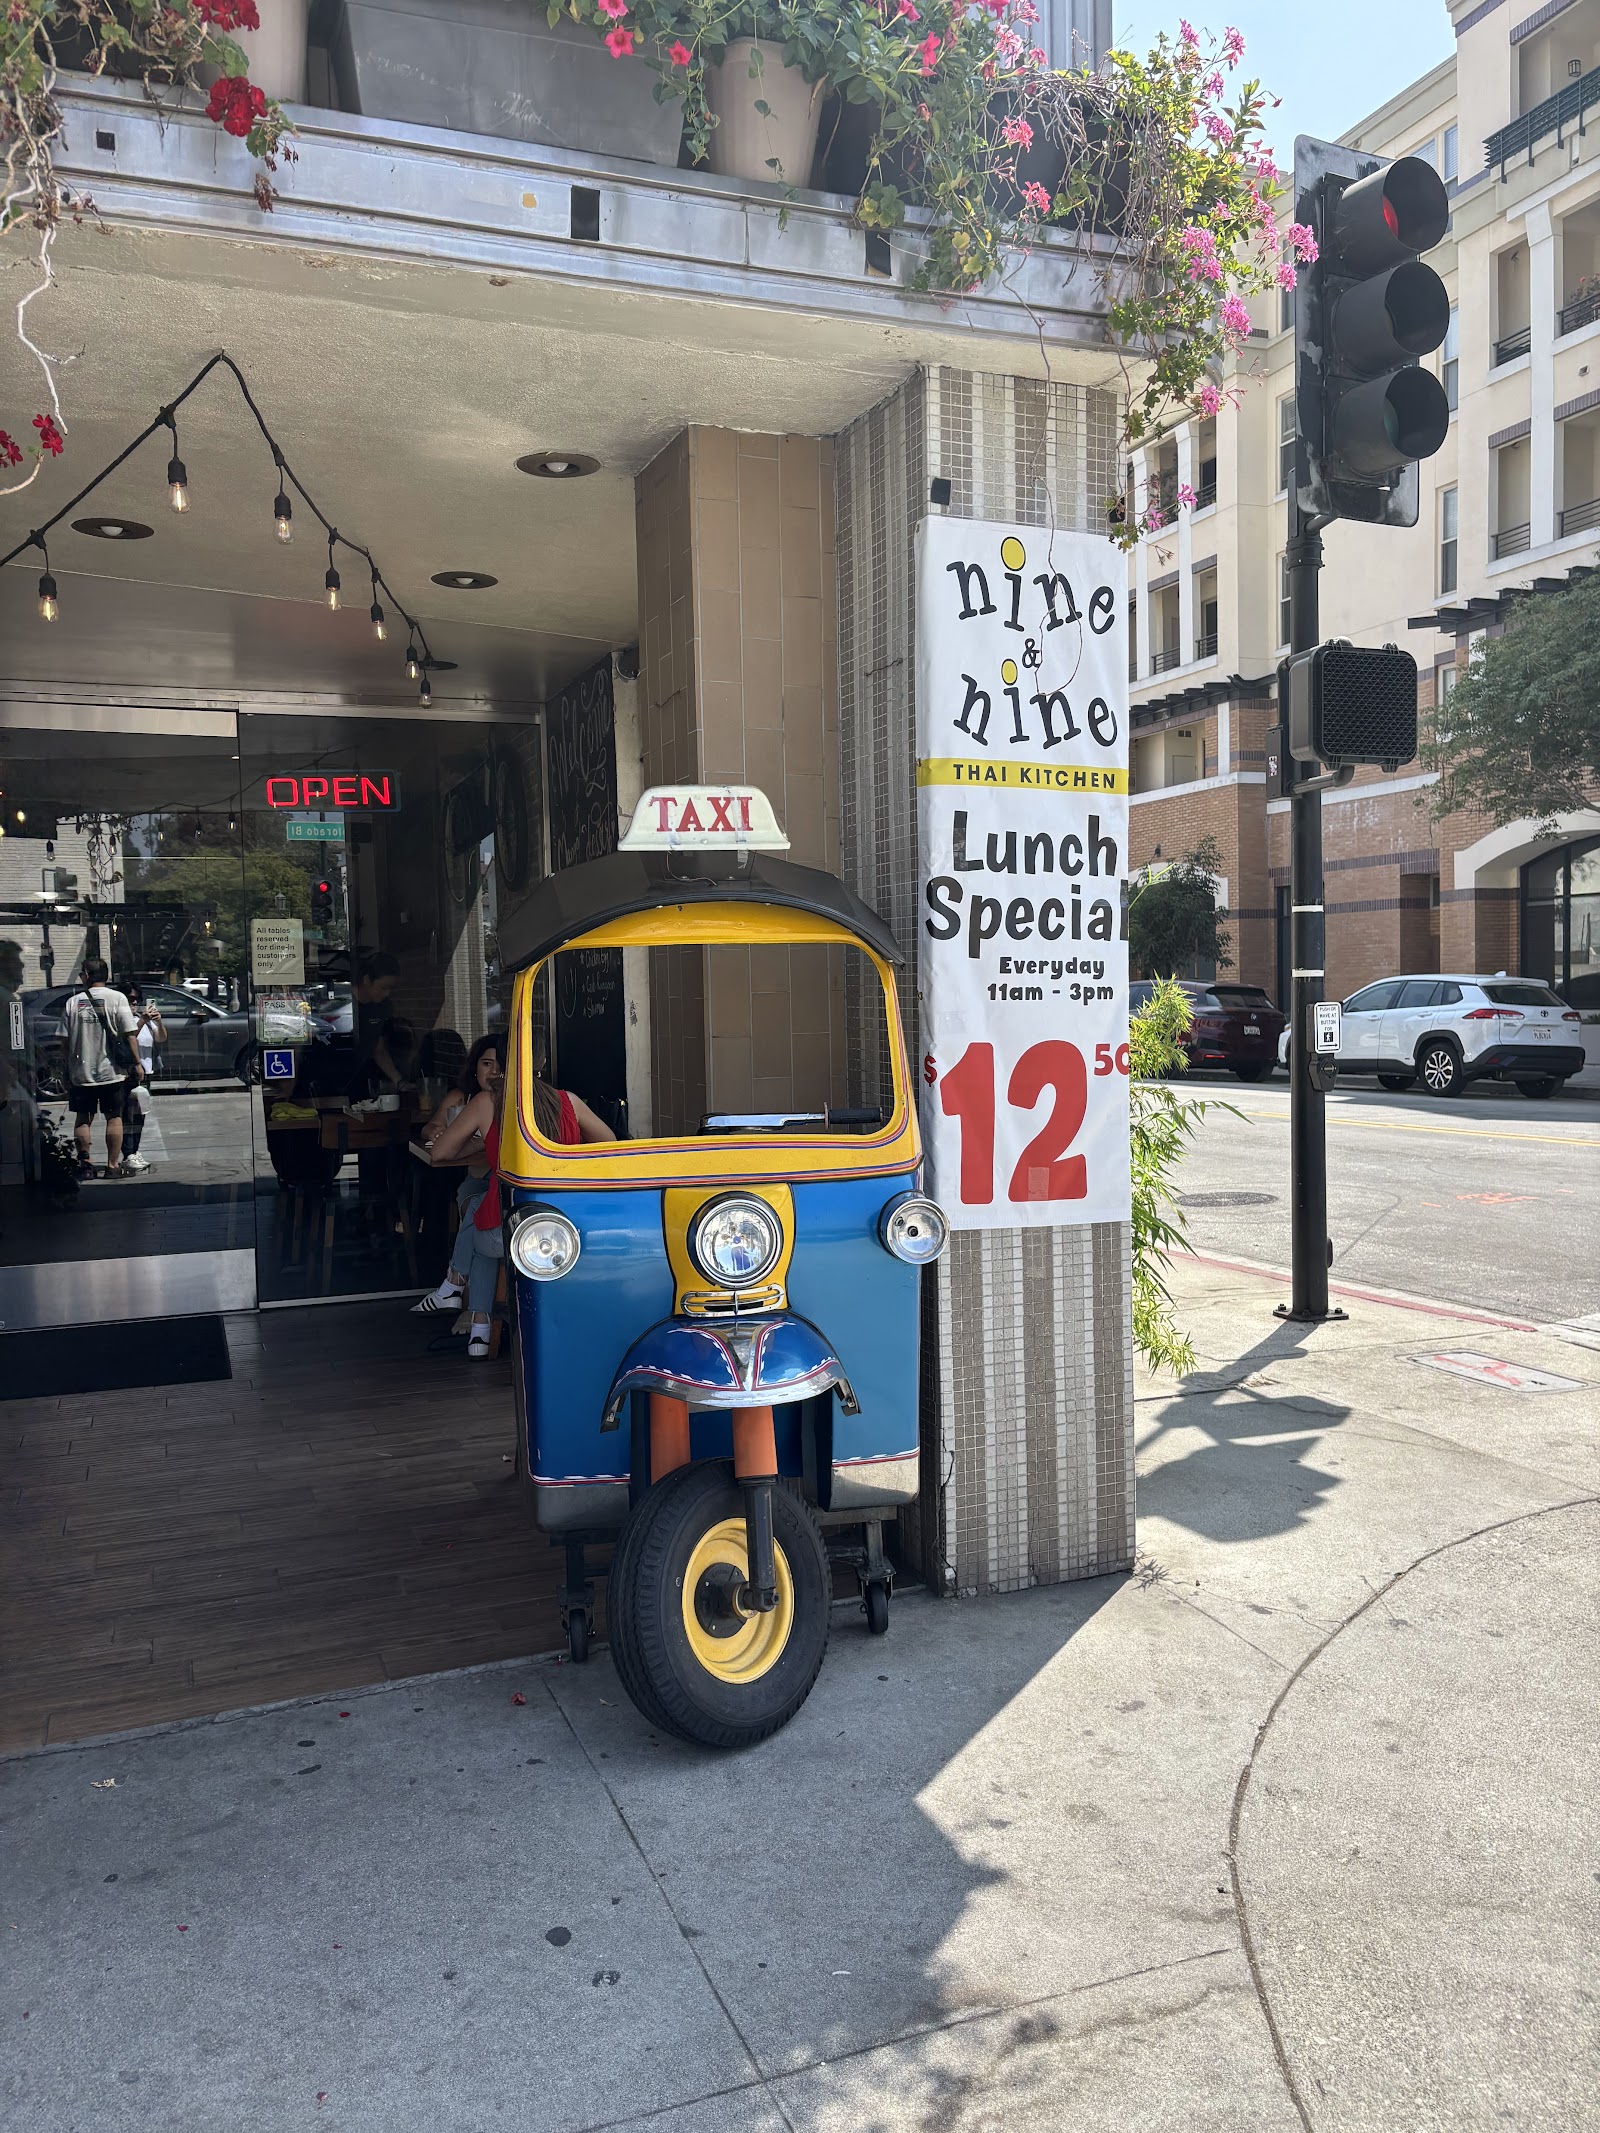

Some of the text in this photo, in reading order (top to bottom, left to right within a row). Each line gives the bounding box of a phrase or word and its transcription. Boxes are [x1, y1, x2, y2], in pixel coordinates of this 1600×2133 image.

[946, 536, 1115, 635] nine
[1021, 637, 1041, 669] &
[953, 658, 1118, 749] nine
[953, 763, 1116, 789] THAI KITCHEN
[266, 777, 391, 807] OPEN
[649, 796, 754, 832] TAXI
[953, 810, 1118, 877] Lunch
[925, 875, 1129, 959] Special
[269, 943, 295, 951] dine-in
[999, 956, 1105, 979] Everyday
[264, 1001, 286, 1009] PASS
[987, 983, 1043, 1001] 11am
[1069, 983, 1114, 1005] 3pm
